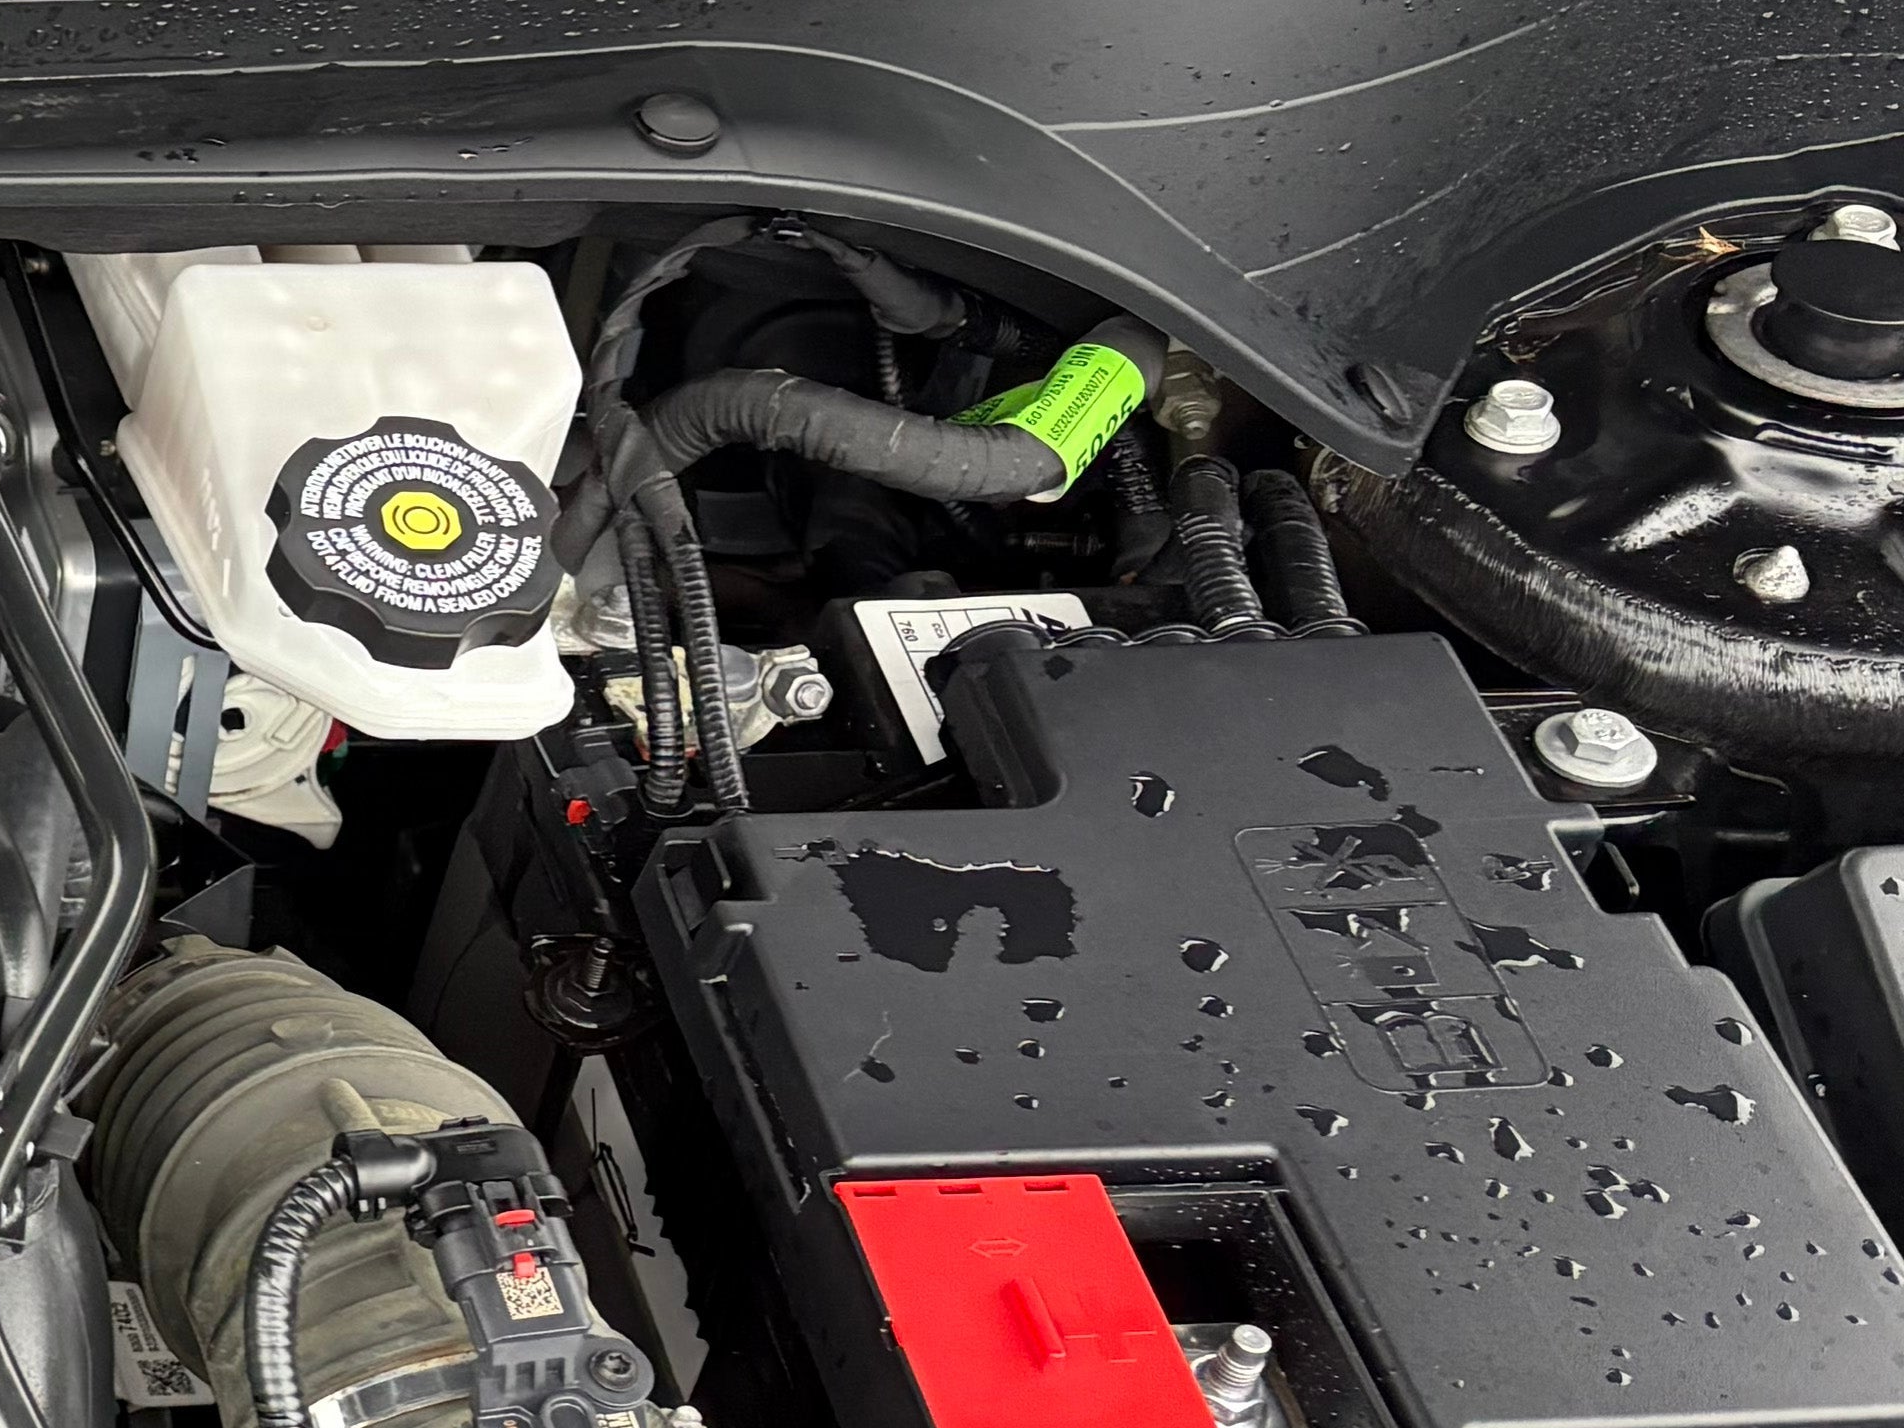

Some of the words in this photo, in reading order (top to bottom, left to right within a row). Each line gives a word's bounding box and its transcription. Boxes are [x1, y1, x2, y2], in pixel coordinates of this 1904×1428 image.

[382, 449, 402, 465] DU
[449, 461, 472, 479] DE
[384, 433, 405, 449] LE
[403, 433, 468, 459] BOUCHON
[464, 452, 509, 482] AVANT
[328, 527, 357, 553] CAP
[345, 549, 404, 590] BEFORE
[494, 533, 519, 565] ONLY
[414, 560, 468, 580] CLEAN
[461, 531, 496, 569] FILLER
[330, 560, 376, 594] FLUID
[374, 585, 424, 612] FROM
[423, 595, 437, 613] A
[437, 589, 498, 613] SEALED
